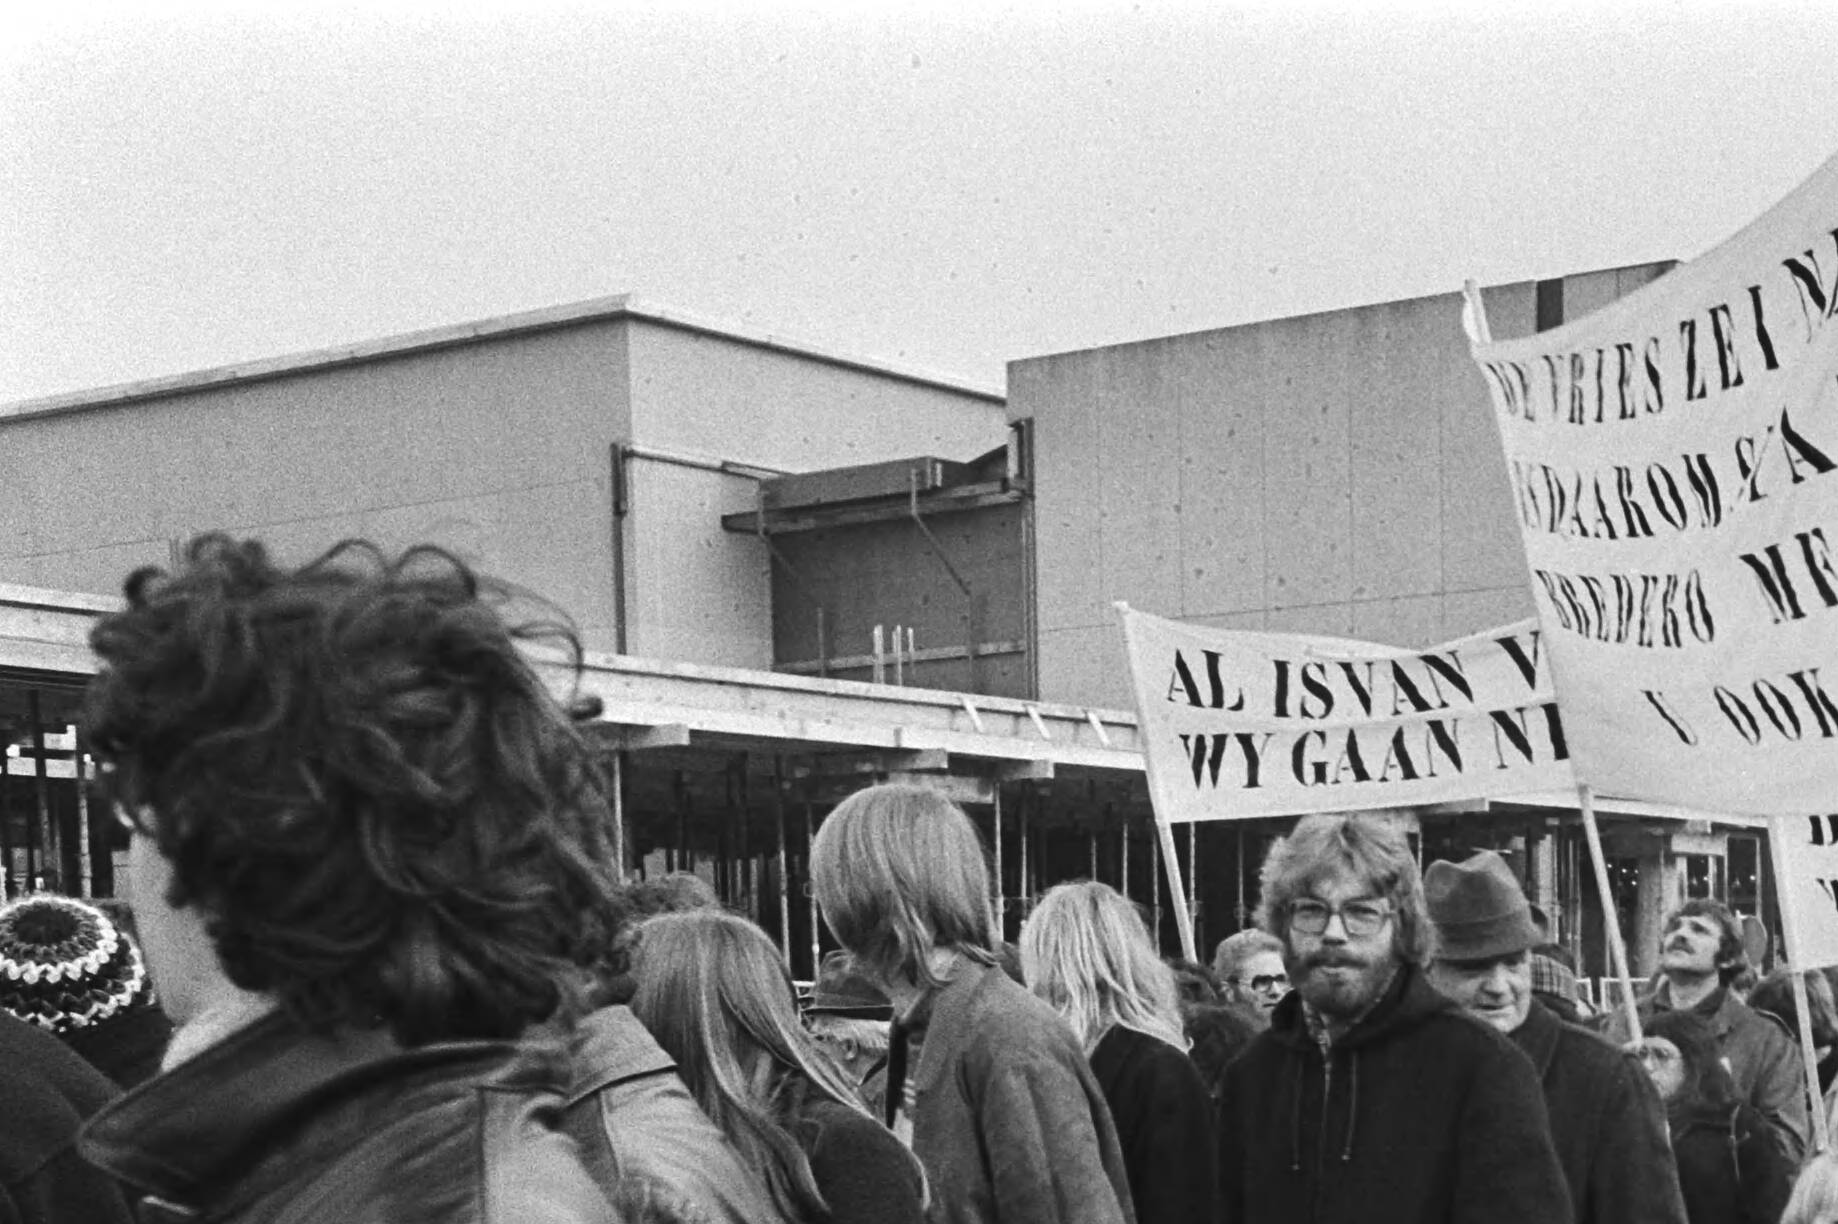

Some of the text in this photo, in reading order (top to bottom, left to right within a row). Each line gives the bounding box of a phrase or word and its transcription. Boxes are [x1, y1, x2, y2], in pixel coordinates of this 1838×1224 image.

[1541, 337, 1664, 426] VRIES
[1678, 284, 1780, 402] ZEI
[1167, 649, 1244, 712] AL
[1179, 732, 1274, 788] WY
[1291, 719, 1459, 788] GAAN
